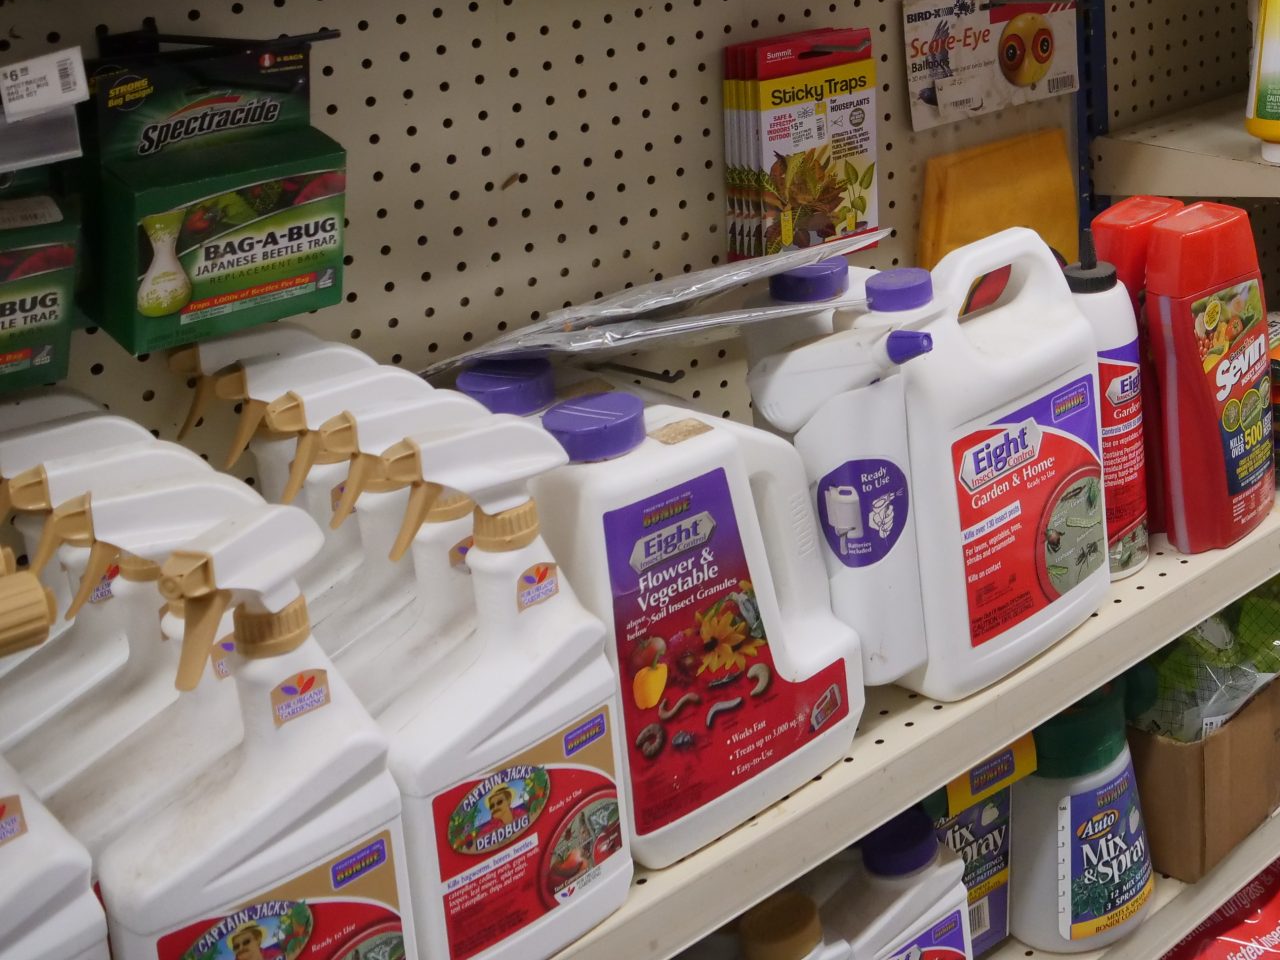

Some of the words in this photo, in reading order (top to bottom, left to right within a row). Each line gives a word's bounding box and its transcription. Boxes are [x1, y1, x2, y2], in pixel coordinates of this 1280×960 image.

[767, 49, 792, 59] Summit
[108, 78, 148, 97] STRONG
[771, 84, 824, 105] Sticky
[825, 75, 867, 94] Traps
[830, 97, 870, 112] HOUSEPLANTS
[138, 97, 280, 155] Spectracide
[203, 217, 338, 262] BAG-A-BUG
[195, 252, 259, 277] JAPANESE
[262, 243, 304, 260] BEETLE
[209, 260, 294, 285] REPLACEMENT
[298, 251, 326, 265] BAGS
[1215, 333, 1267, 401] Sevin
[971, 471, 995, 489] Insect
[1007, 447, 1035, 468] Control
[972, 429, 1027, 476] Eight
[860, 466, 887, 484] Ready
[862, 481, 872, 493] to
[874, 475, 890, 490] Use
[971, 479, 1010, 509] Garden
[1011, 474, 1021, 489] &
[1022, 458, 1054, 482] Home
[641, 521, 702, 556] Eight
[637, 563, 719, 613] Vegetable
[639, 559, 696, 595] Flower
[700, 548, 714, 564] &
[968, 574, 978, 583] Kills
[986, 561, 1001, 575] contact
[651, 608, 667, 624] Soil
[668, 596, 695, 618] Insect
[697, 577, 737, 601] Granules
[626, 617, 646, 631] above
[626, 628, 648, 641] below
[276, 701, 292, 715] FOR
[293, 687, 326, 708] ORGANIC
[279, 698, 325, 721] GARDENING
[731, 727, 751, 743] Works
[752, 720, 767, 733] Fast
[736, 748, 774, 775] Easy-to-Use
[462, 774, 502, 811] CAPTAIN
[504, 767, 533, 782] JACK'S
[476, 817, 530, 851] DEADBUG
[1082, 815, 1115, 839] Auto
[1081, 832, 1128, 869] Mix
[1084, 871, 1098, 884] &
[1098, 833, 1145, 884] Spray
[1111, 890, 1119, 899] 12
[1122, 880, 1135, 893] MIX
[198, 911, 249, 953] CAPTAIN
[253, 901, 289, 919] JACK'S
[311, 938, 332, 952] Ready
[334, 932, 342, 940] to
[343, 923, 356, 934] Use
